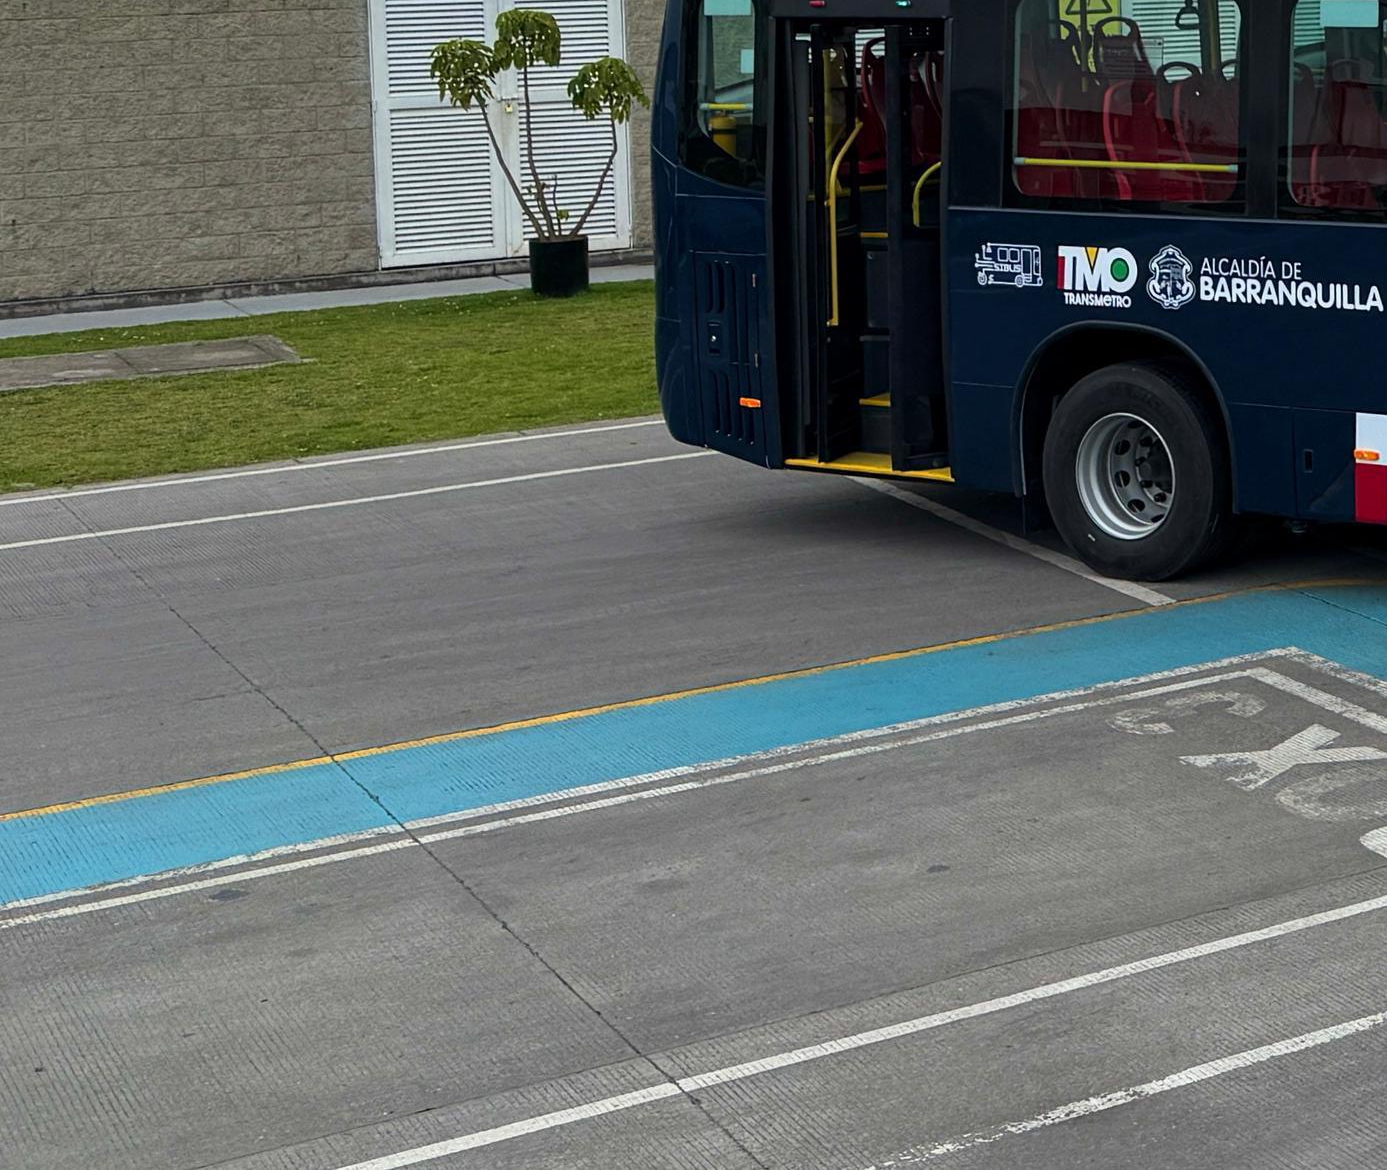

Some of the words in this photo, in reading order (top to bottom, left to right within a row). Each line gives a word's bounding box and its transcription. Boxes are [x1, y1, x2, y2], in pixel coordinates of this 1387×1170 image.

[1056, 245, 1138, 293] TMO
[1200, 256, 1276, 279] ALCALDÍA
[1281, 261, 1302, 280] DE
[1200, 276, 1384, 312] BARRANQUILLA
